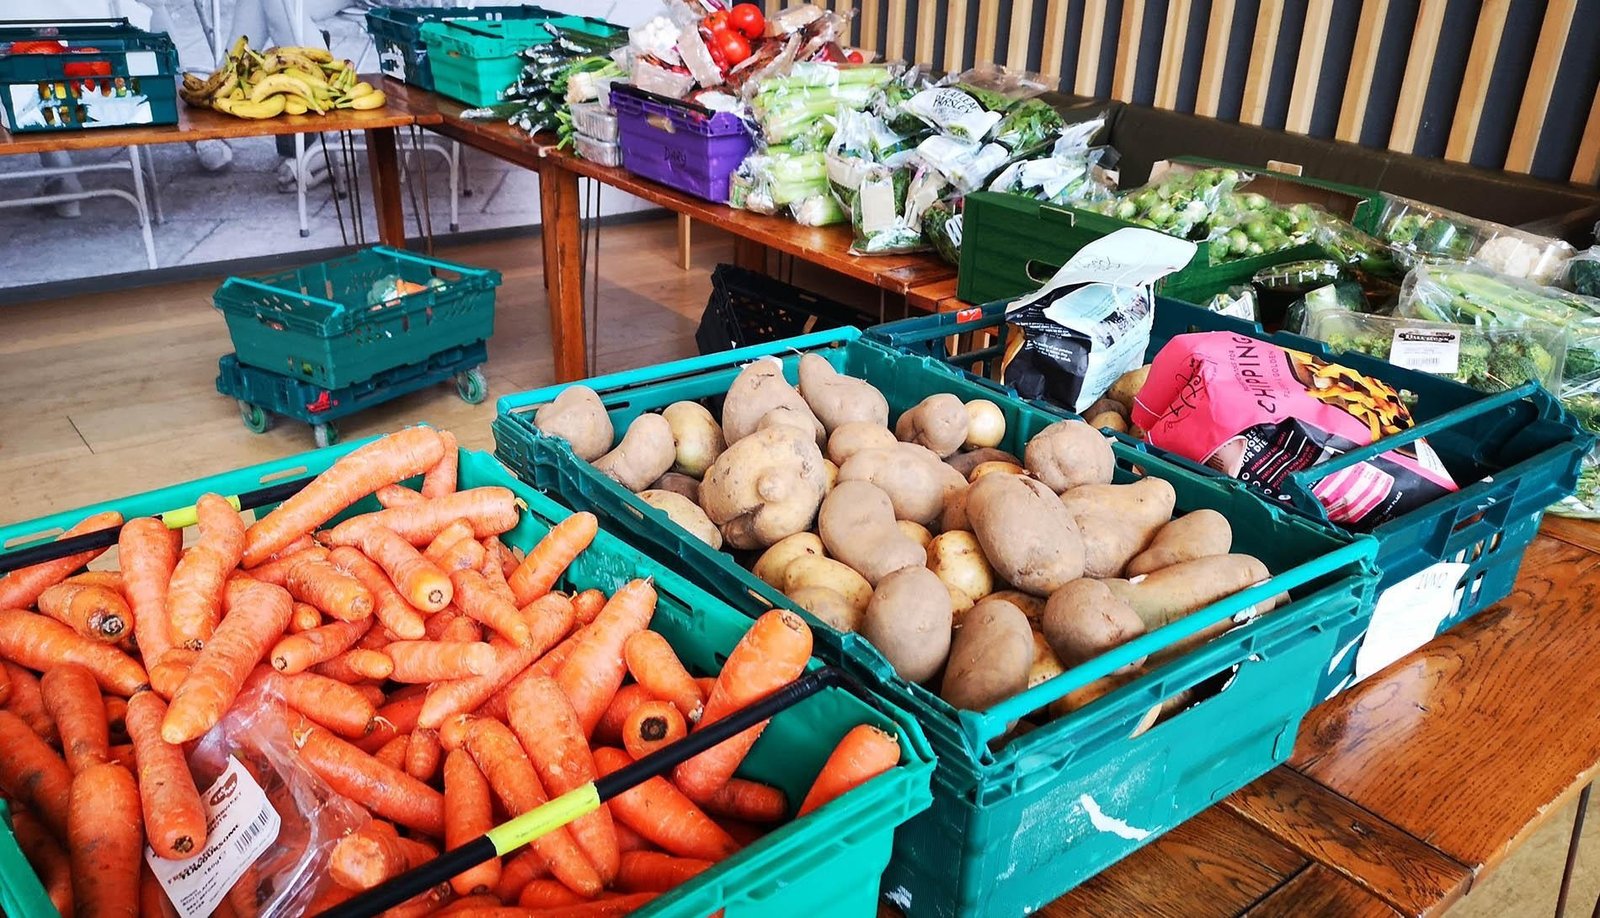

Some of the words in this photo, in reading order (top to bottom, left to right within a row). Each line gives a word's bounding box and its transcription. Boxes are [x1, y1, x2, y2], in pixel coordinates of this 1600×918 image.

[1232, 336, 1276, 414] CHIPPING
[1269, 350, 1280, 377] GOLDEN
[1253, 440, 1269, 453] DIE
[1250, 450, 1273, 471] NATURALLY
